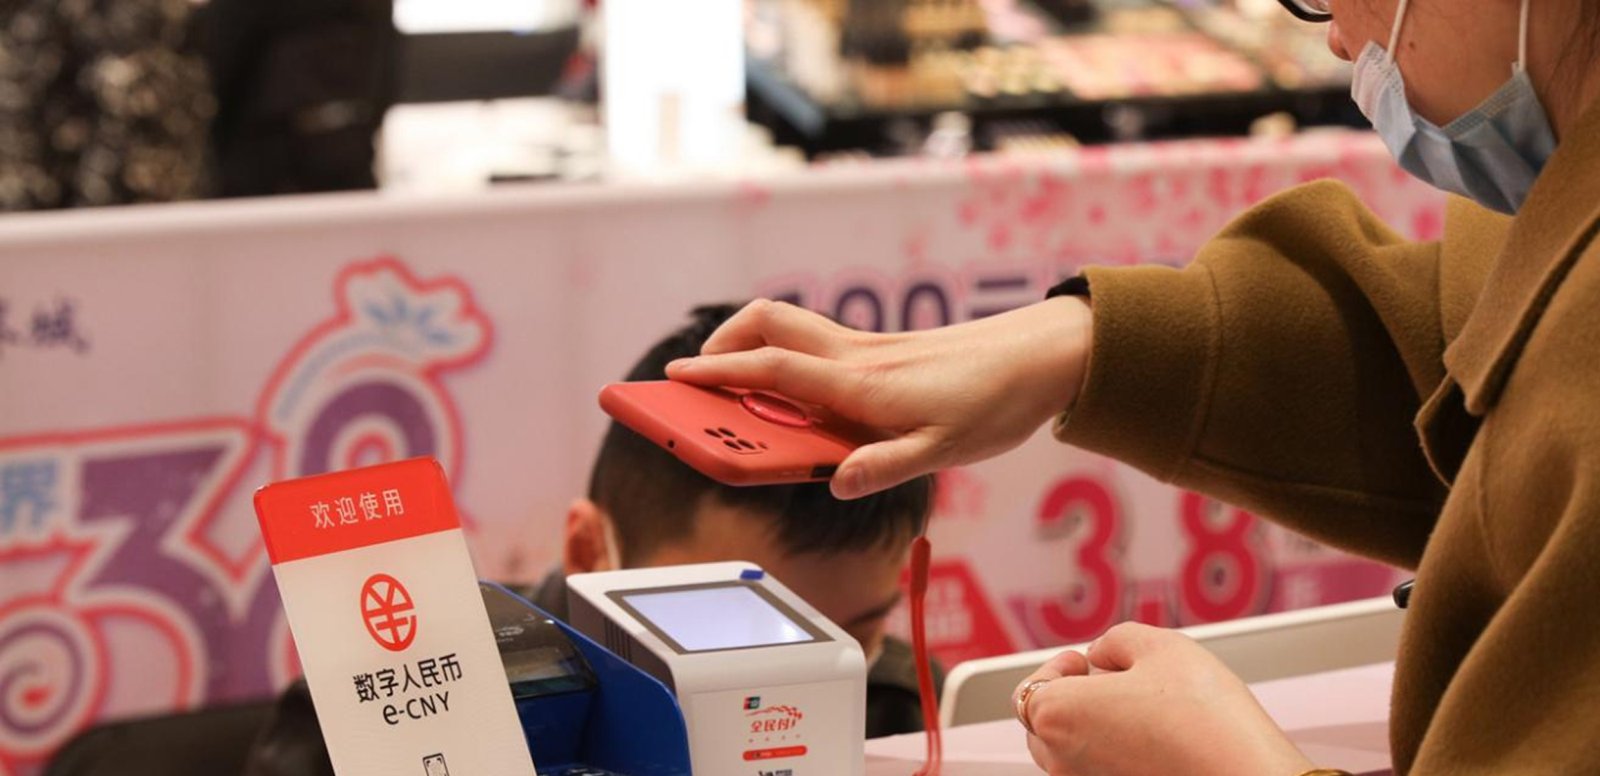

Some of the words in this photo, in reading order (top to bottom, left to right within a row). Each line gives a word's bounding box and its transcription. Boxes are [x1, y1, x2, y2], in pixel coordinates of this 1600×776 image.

[310, 488, 405, 529] 欢迎使用
[352, 653, 463, 703] 数字人民币
[382, 691, 451, 725] e-CNY
